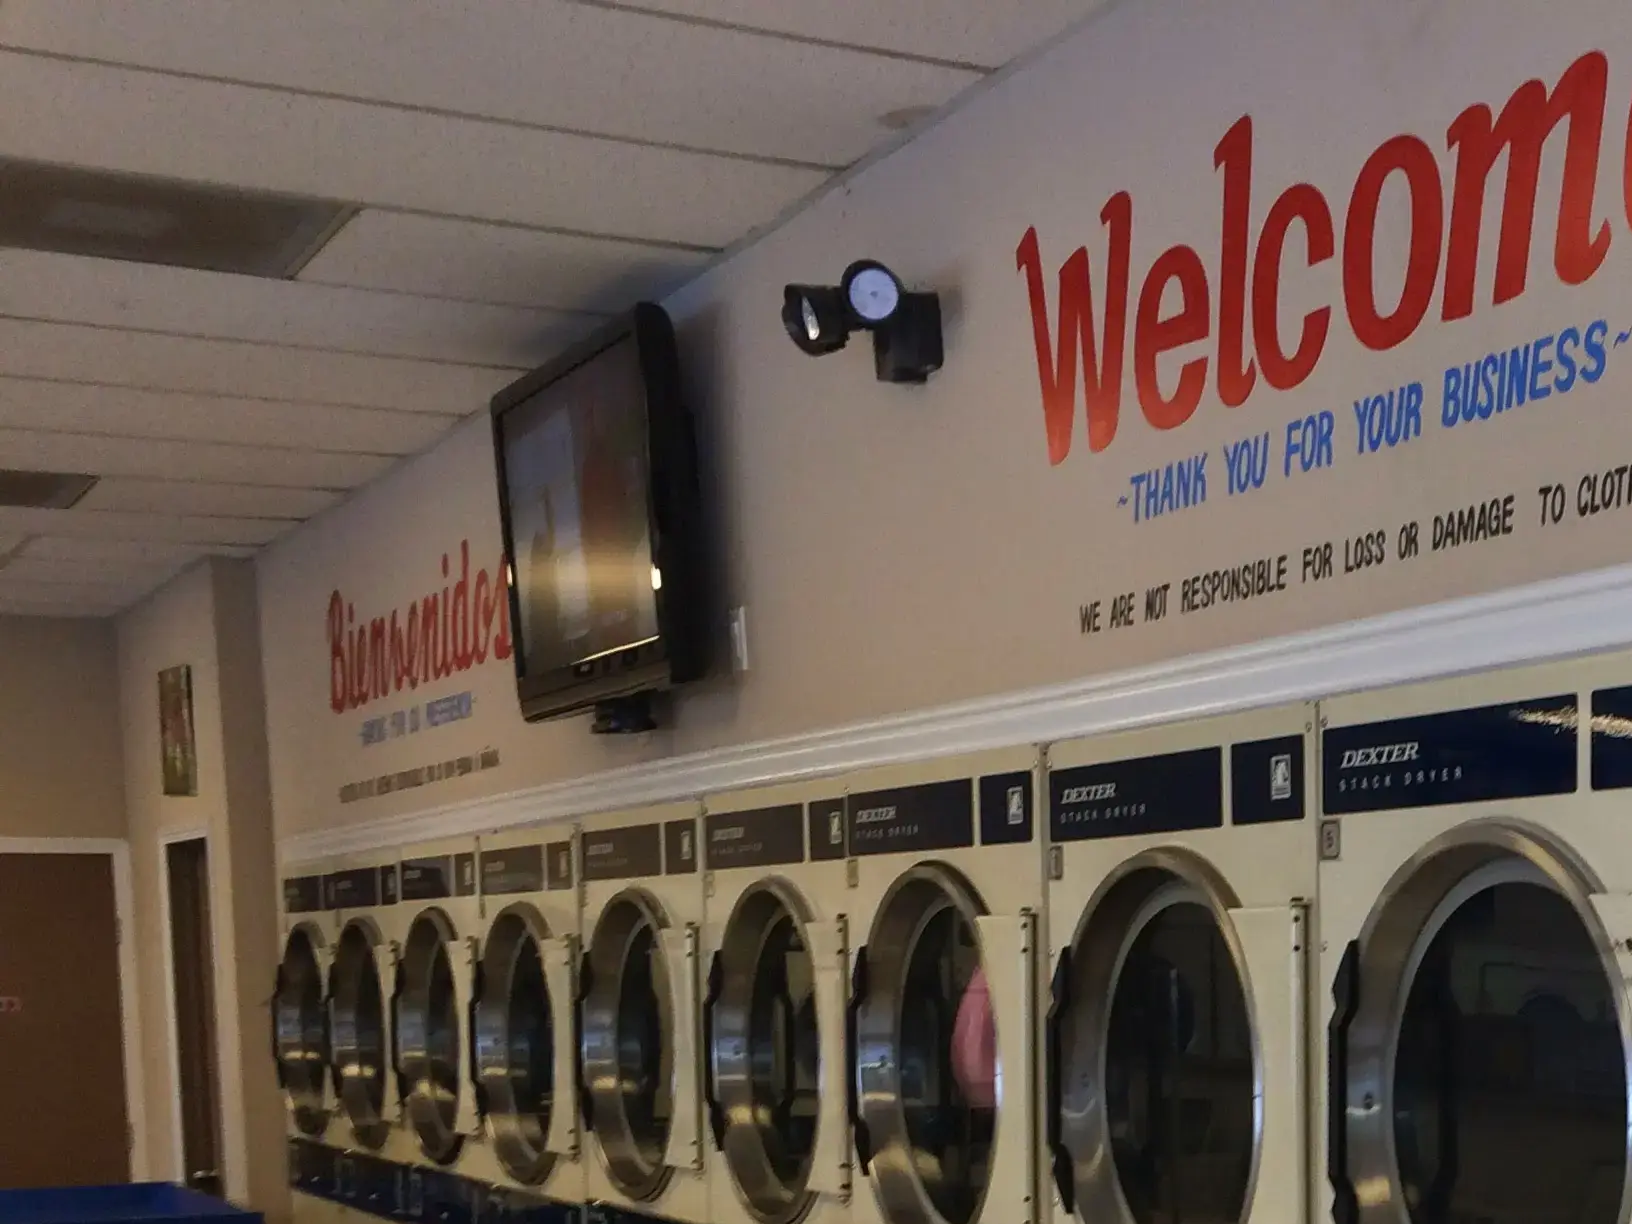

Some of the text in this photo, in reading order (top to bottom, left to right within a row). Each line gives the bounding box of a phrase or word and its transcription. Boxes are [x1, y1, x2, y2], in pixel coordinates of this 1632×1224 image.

[1224, 433, 1270, 497] YOU
[1284, 408, 1335, 478] FOR
[1353, 380, 1424, 455] YOUR
[1079, 600, 1102, 635] WE
[1109, 591, 1136, 630] ARE
[1145, 582, 1170, 622] NOT
[1181, 554, 1288, 615] RESPONSIBLE
[1302, 541, 1334, 584] FOR
[1344, 529, 1386, 574] LOSS
[1397, 517, 1420, 561] OR
[1431, 494, 1515, 551] DAMAGE
[1537, 482, 1567, 527] TO
[1340, 741, 1420, 769] DEXTER
[1060, 782, 1117, 805] DEXTER
